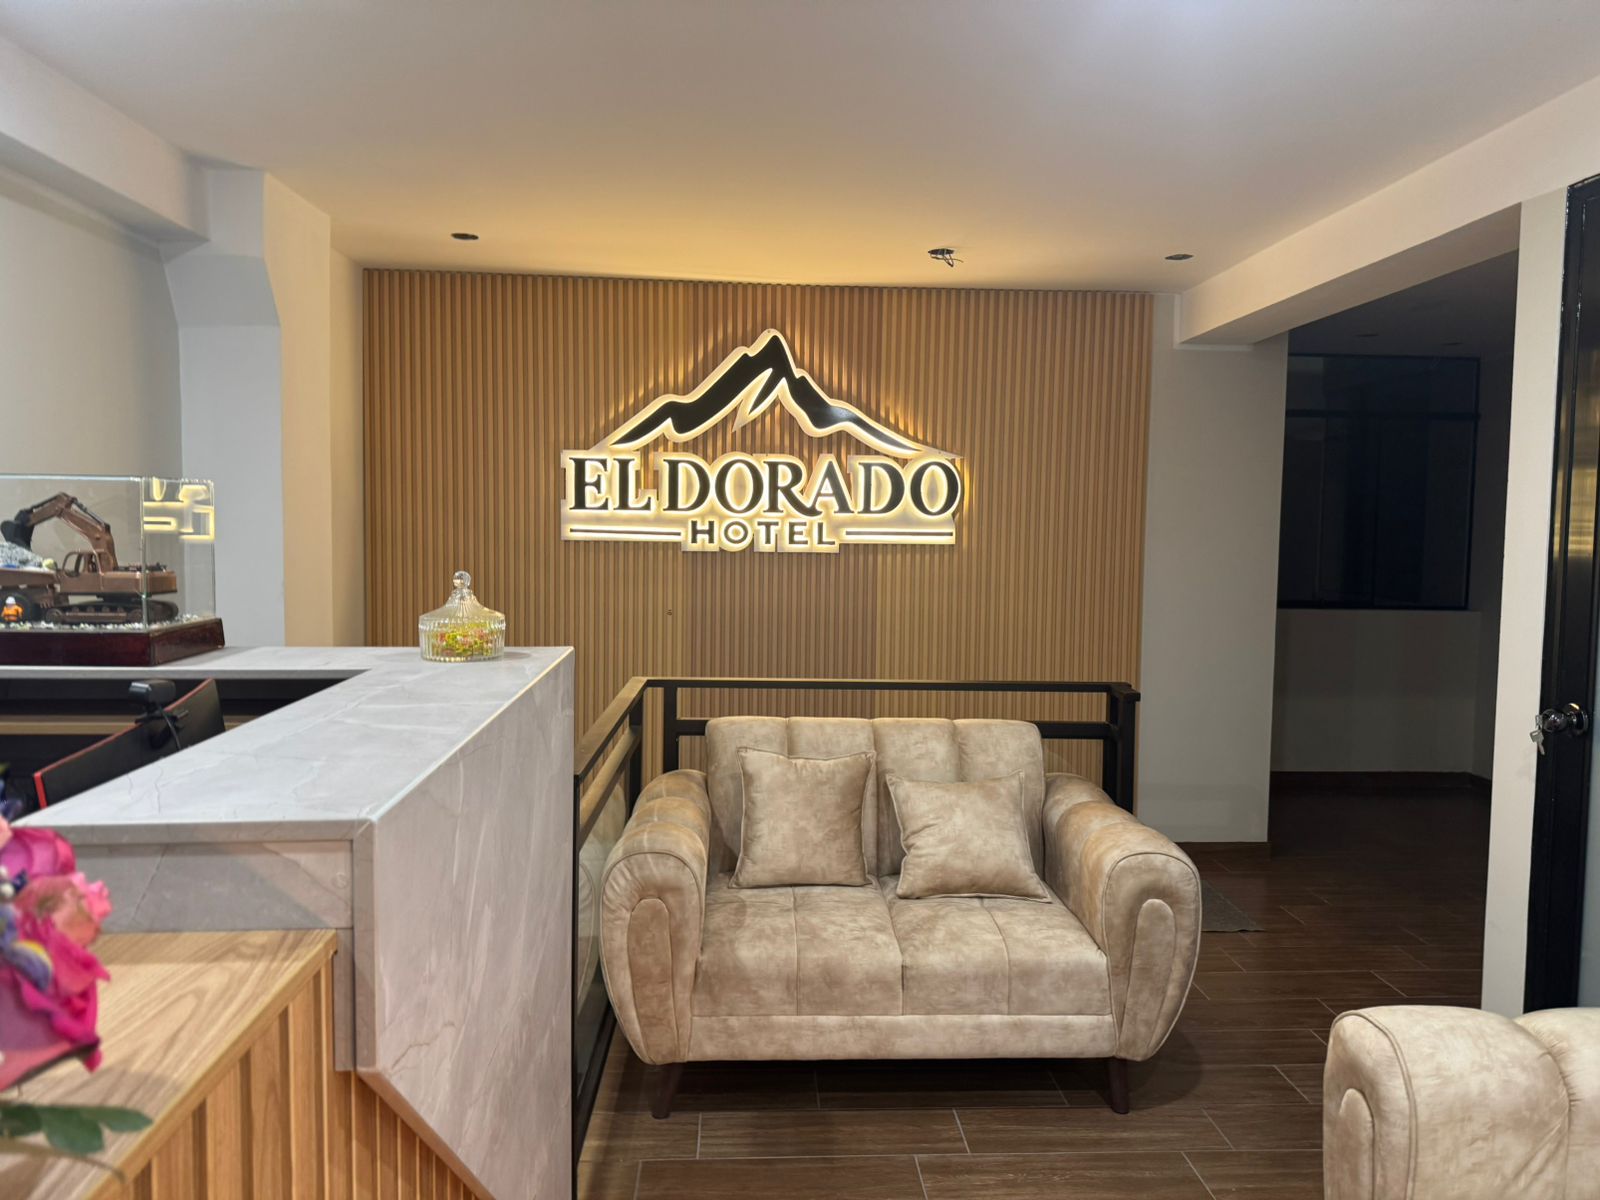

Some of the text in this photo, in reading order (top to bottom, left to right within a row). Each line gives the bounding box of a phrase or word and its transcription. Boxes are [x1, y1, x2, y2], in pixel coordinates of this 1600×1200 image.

[569, 457, 959, 516] EL DORADO
[690, 520, 835, 545] HOTEL
